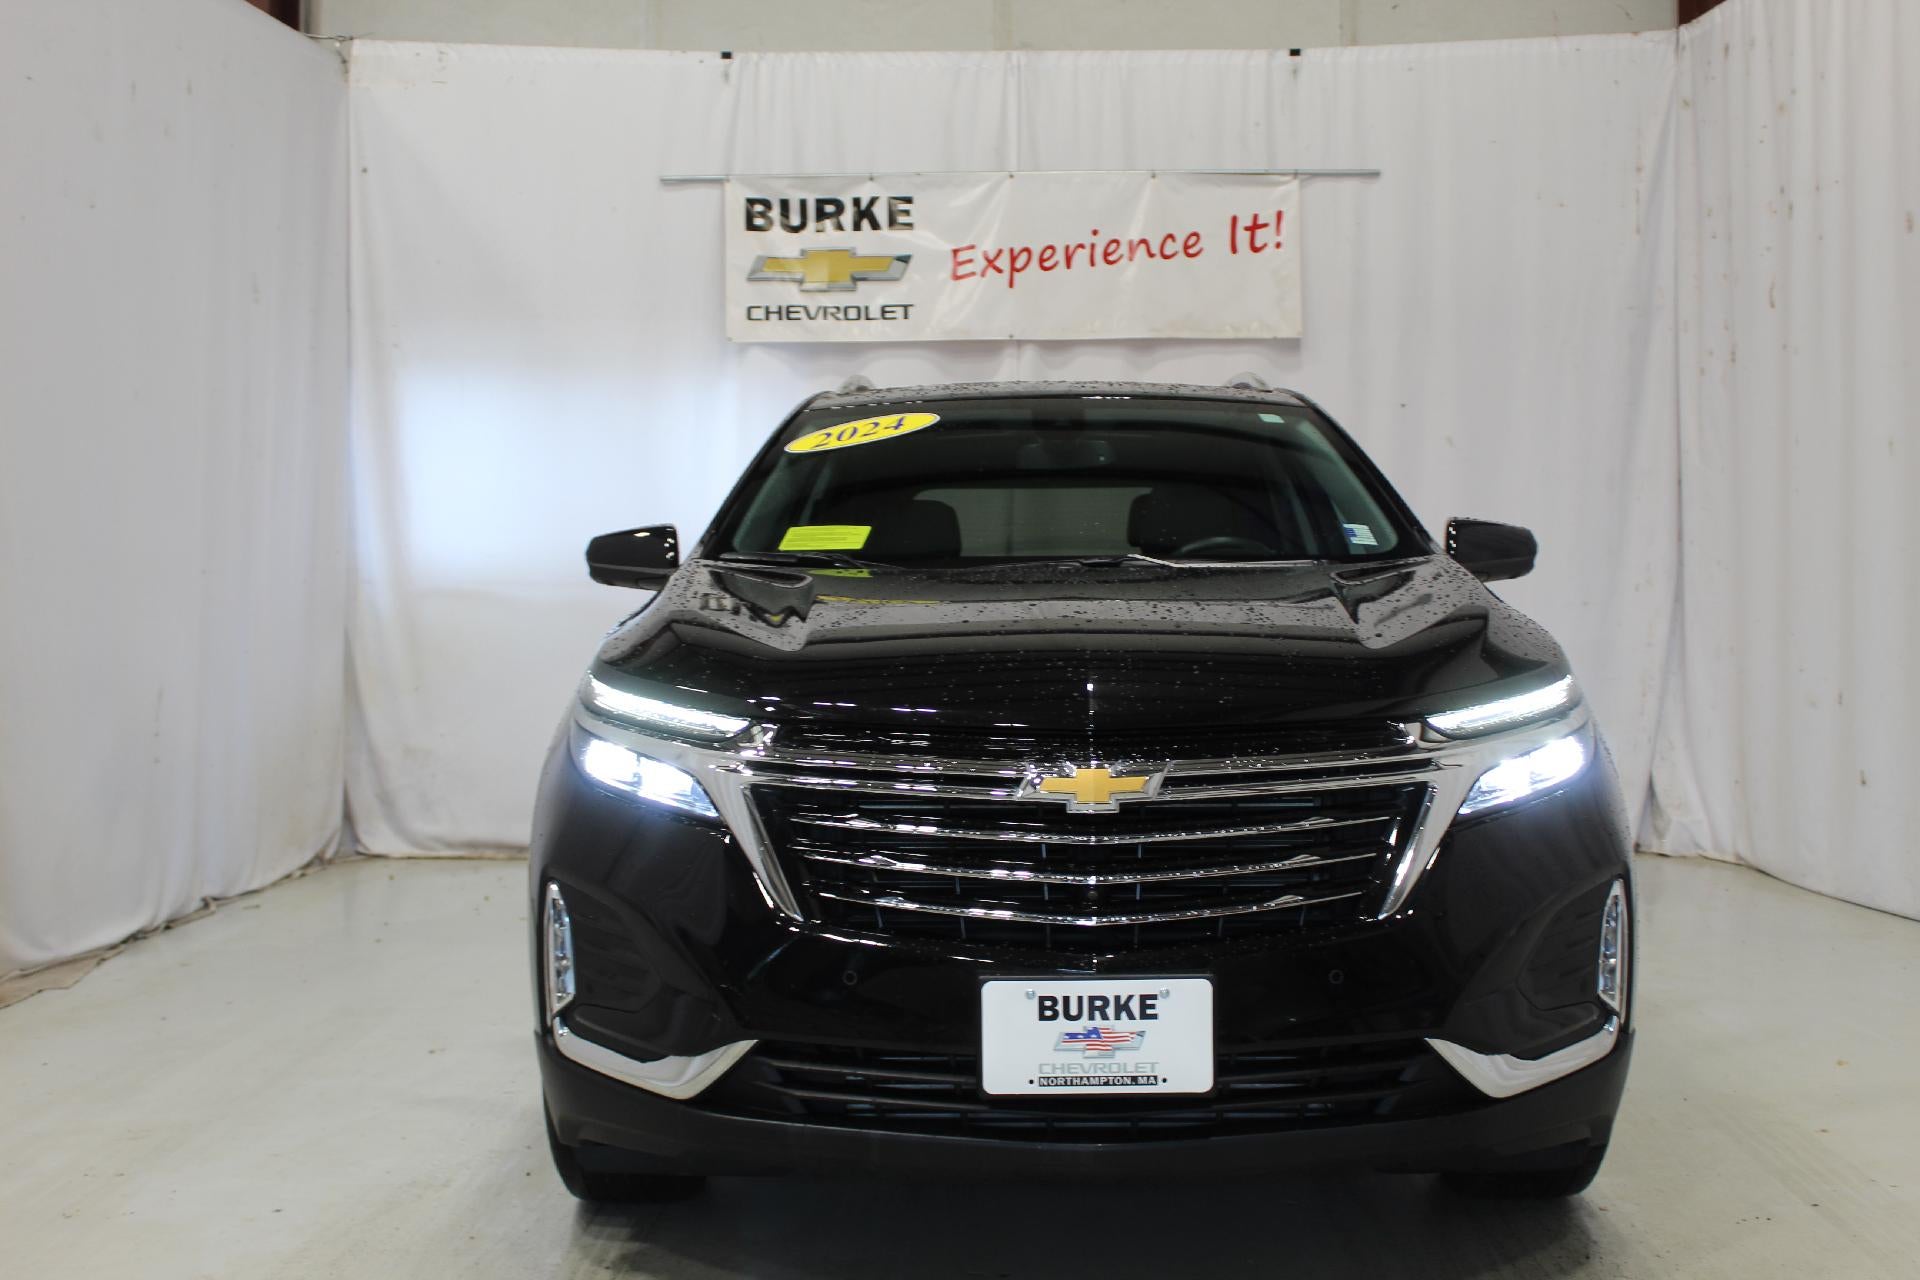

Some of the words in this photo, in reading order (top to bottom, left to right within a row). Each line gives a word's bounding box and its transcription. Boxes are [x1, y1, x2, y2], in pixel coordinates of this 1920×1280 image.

[745, 196, 914, 233] BURKE
[950, 229, 1203, 287] Experience
[1229, 210, 1285, 255] It!
[746, 304, 914, 321] CHEVROLET
[813, 416, 906, 448] 2024
[1038, 994, 1158, 1021] BURKE
[1038, 1062, 1159, 1074] CHEVROLET
[1137, 1075, 1157, 1085] MA
